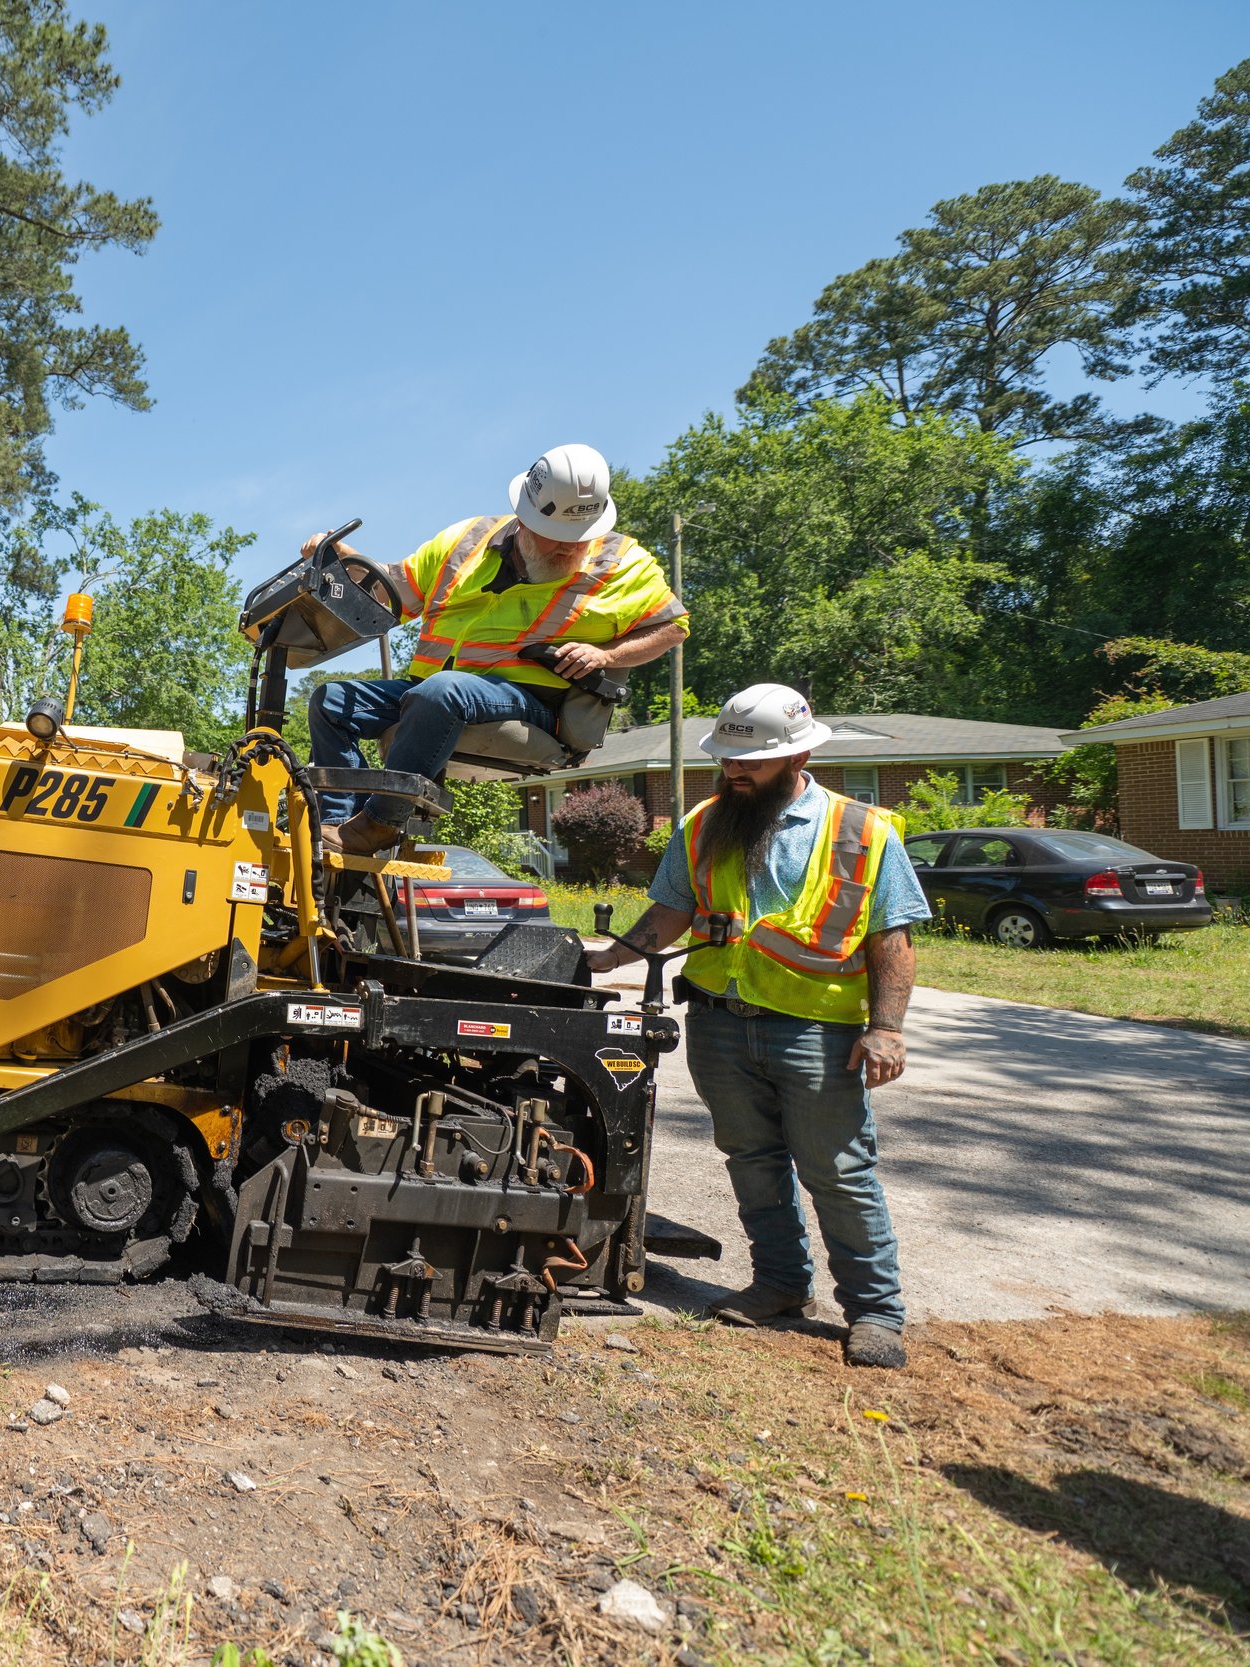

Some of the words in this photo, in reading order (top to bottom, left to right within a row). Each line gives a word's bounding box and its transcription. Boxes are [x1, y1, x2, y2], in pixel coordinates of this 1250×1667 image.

[578, 503, 600, 512] SCS
[728, 724, 754, 732] SCS
[0, 767, 117, 822] P285
